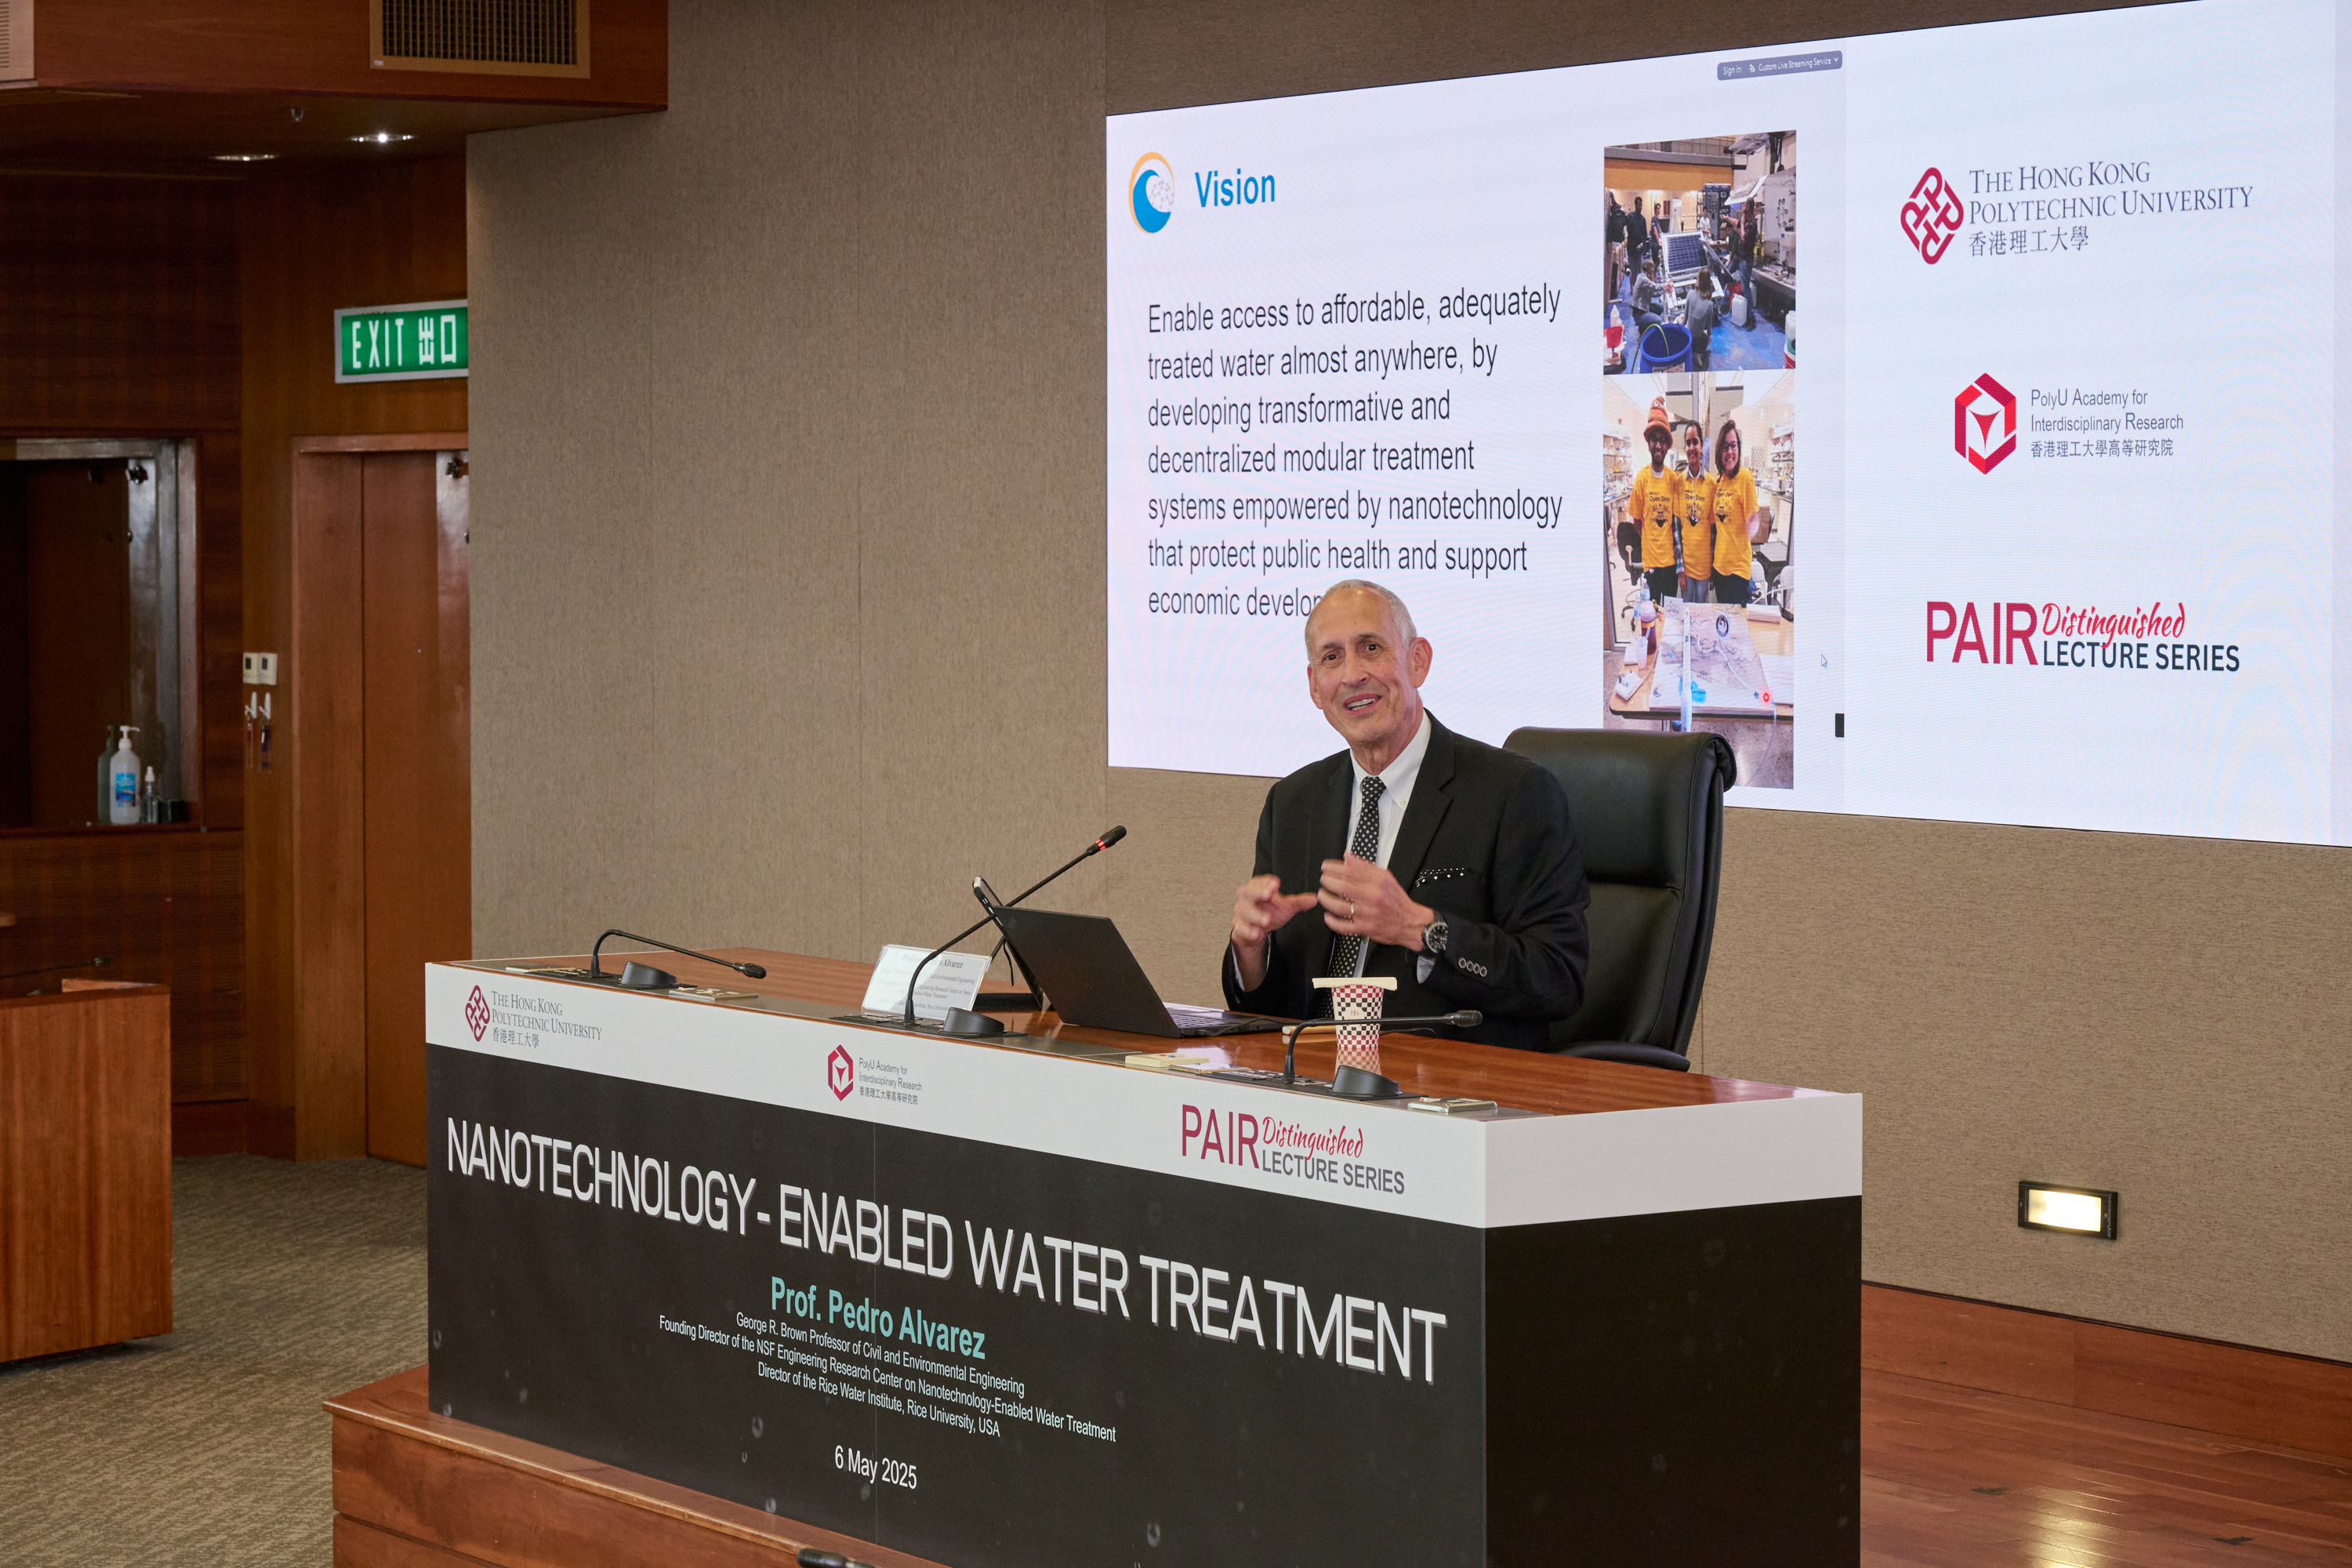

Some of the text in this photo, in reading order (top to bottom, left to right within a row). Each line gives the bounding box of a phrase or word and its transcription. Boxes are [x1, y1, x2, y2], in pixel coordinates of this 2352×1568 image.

[1723, 67, 1735, 76] Sign
[1789, 60, 1813, 68] Streaming
[1813, 57, 1831, 66] Service
[1195, 169, 1275, 207] Vision
[1969, 162, 2149, 193] THE HONG KONG
[1970, 187, 2252, 223] POLYTECHNIC UNIVERSITY
[1969, 226, 2088, 256] 香港理工大學
[1149, 283, 1560, 332] Enable access to affordable, adequately
[352, 318, 403, 369] EXIT
[419, 315, 456, 365] 出口
[1149, 338, 1497, 379] treated water almost anywhere, by
[1149, 389, 1449, 433] developing transformative and
[2031, 388, 2147, 410] PolyU Academy for
[2032, 412, 2183, 434] Interdisciplinary Research
[1149, 441, 1474, 473] decentralized modular treatment
[2031, 438, 2173, 457] 香港理工大學高等研究院
[1149, 489, 1562, 528] systems empowered by nanotechnology
[1149, 539, 1526, 579] that protect public health and support
[1149, 586, 1240, 615] economic
[1926, 601, 2038, 665] PAIR
[2042, 602, 2185, 648] Distinguished
[2044, 641, 2240, 672] LECTURE SERIES
[943, 959, 964, 969] Alvarez
[492, 991, 562, 1015] THE HONG KONG
[492, 1009, 601, 1040] POLYTECHNIC UNIVERSITY
[492, 1028, 539, 1048] 香港理工大學
[859, 1058, 874, 1070] PolyU
[877, 1061, 899, 1075] Academy
[859, 1072, 922, 1091] Interdisciplinary Research
[860, 1087, 918, 1105] 香港理工大學高等研究院
[1182, 1104, 1259, 1168] PAIR
[1262, 1116, 1363, 1160] Distinguished
[1262, 1149, 1405, 1195] LECTURE SERIES
[780, 1184, 953, 1280] ENABLED
[964, 1219, 1130, 1320] WATER
[1139, 1254, 1447, 1384] TREATMENT
[771, 1276, 985, 1360] Prof. Pedro Alvarez
[737, 1312, 1024, 1399] George R. Brown Professor of Civil and Environmental Engineering
[660, 1315, 1116, 1442] Founding Director of the NSF Engineering Research Center on Nanotechnology-Enabled Water Treatment
[759, 1362, 1000, 1437] Director of the Rice Water Institute, Rice University, USA
[835, 1445, 916, 1489] 6 May 2025
